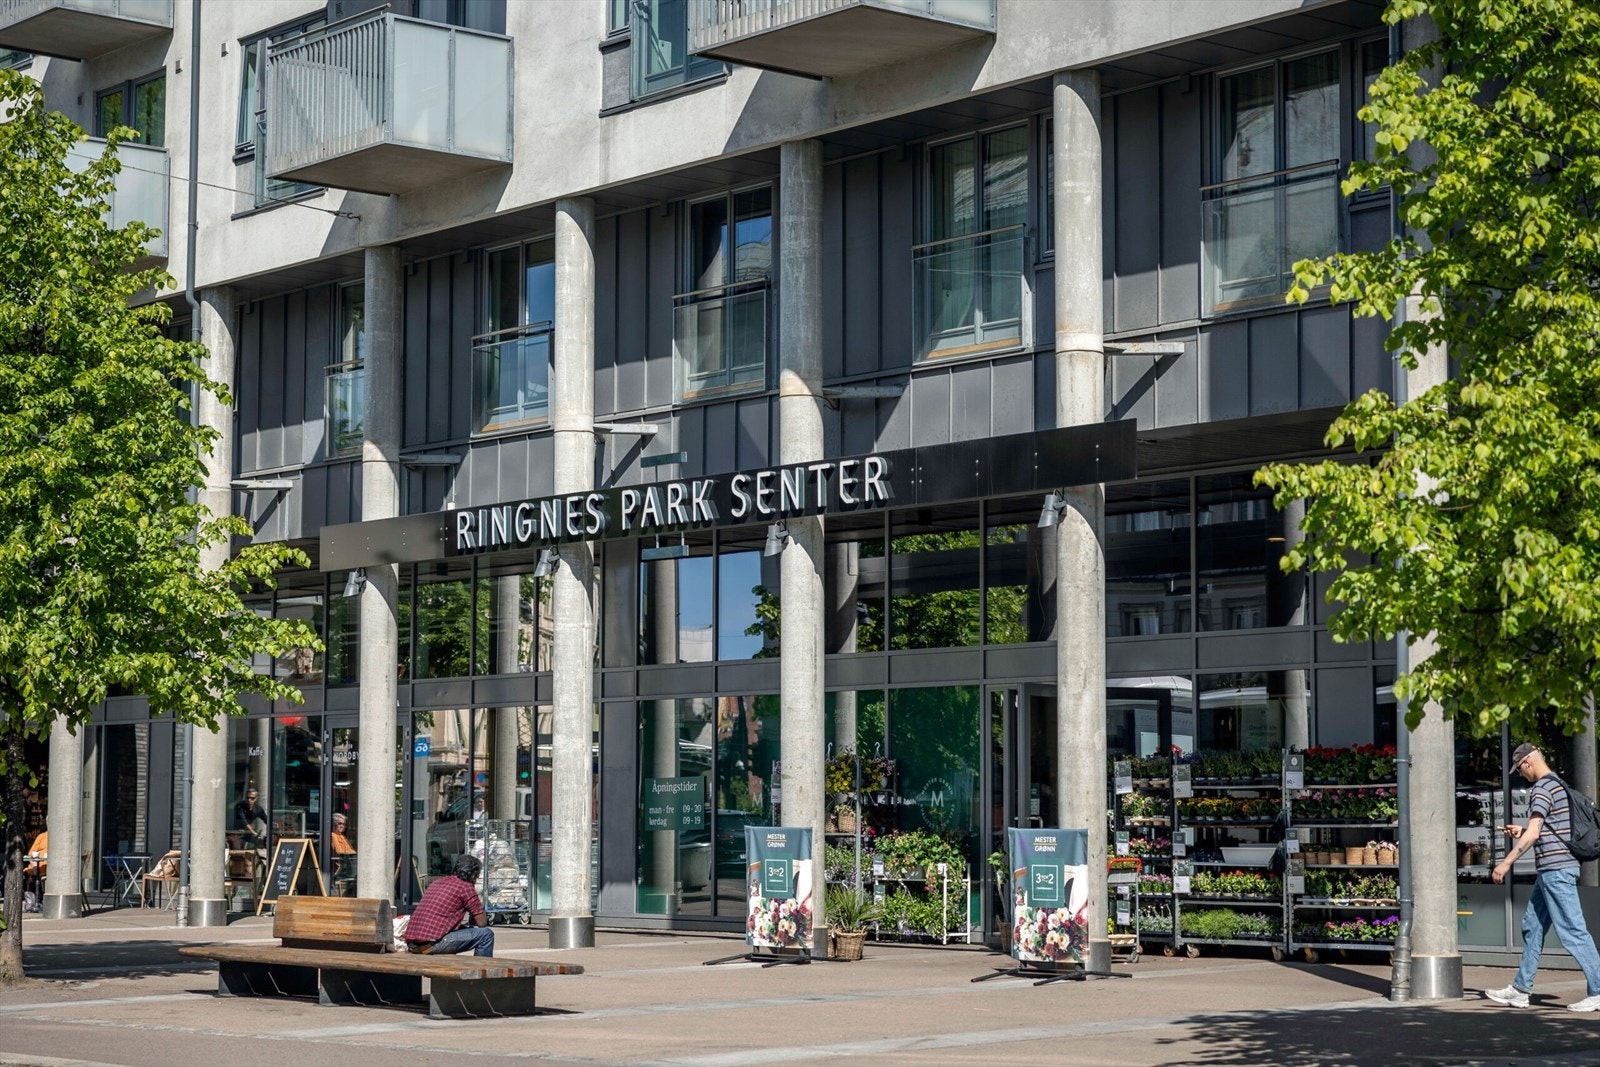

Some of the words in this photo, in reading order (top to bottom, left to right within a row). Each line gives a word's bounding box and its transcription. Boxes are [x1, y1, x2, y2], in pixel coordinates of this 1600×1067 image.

[456, 493, 607, 550] RINGNES
[621, 479, 714, 531] PARK
[730, 456, 890, 518] SENTER
[248, 746, 264, 756] Kaffe
[652, 780, 697, 794] Åpningstider
[930, 790, 945, 807] M
[1035, 873, 1042, 884] 3
[1048, 873, 1055, 884] 2
